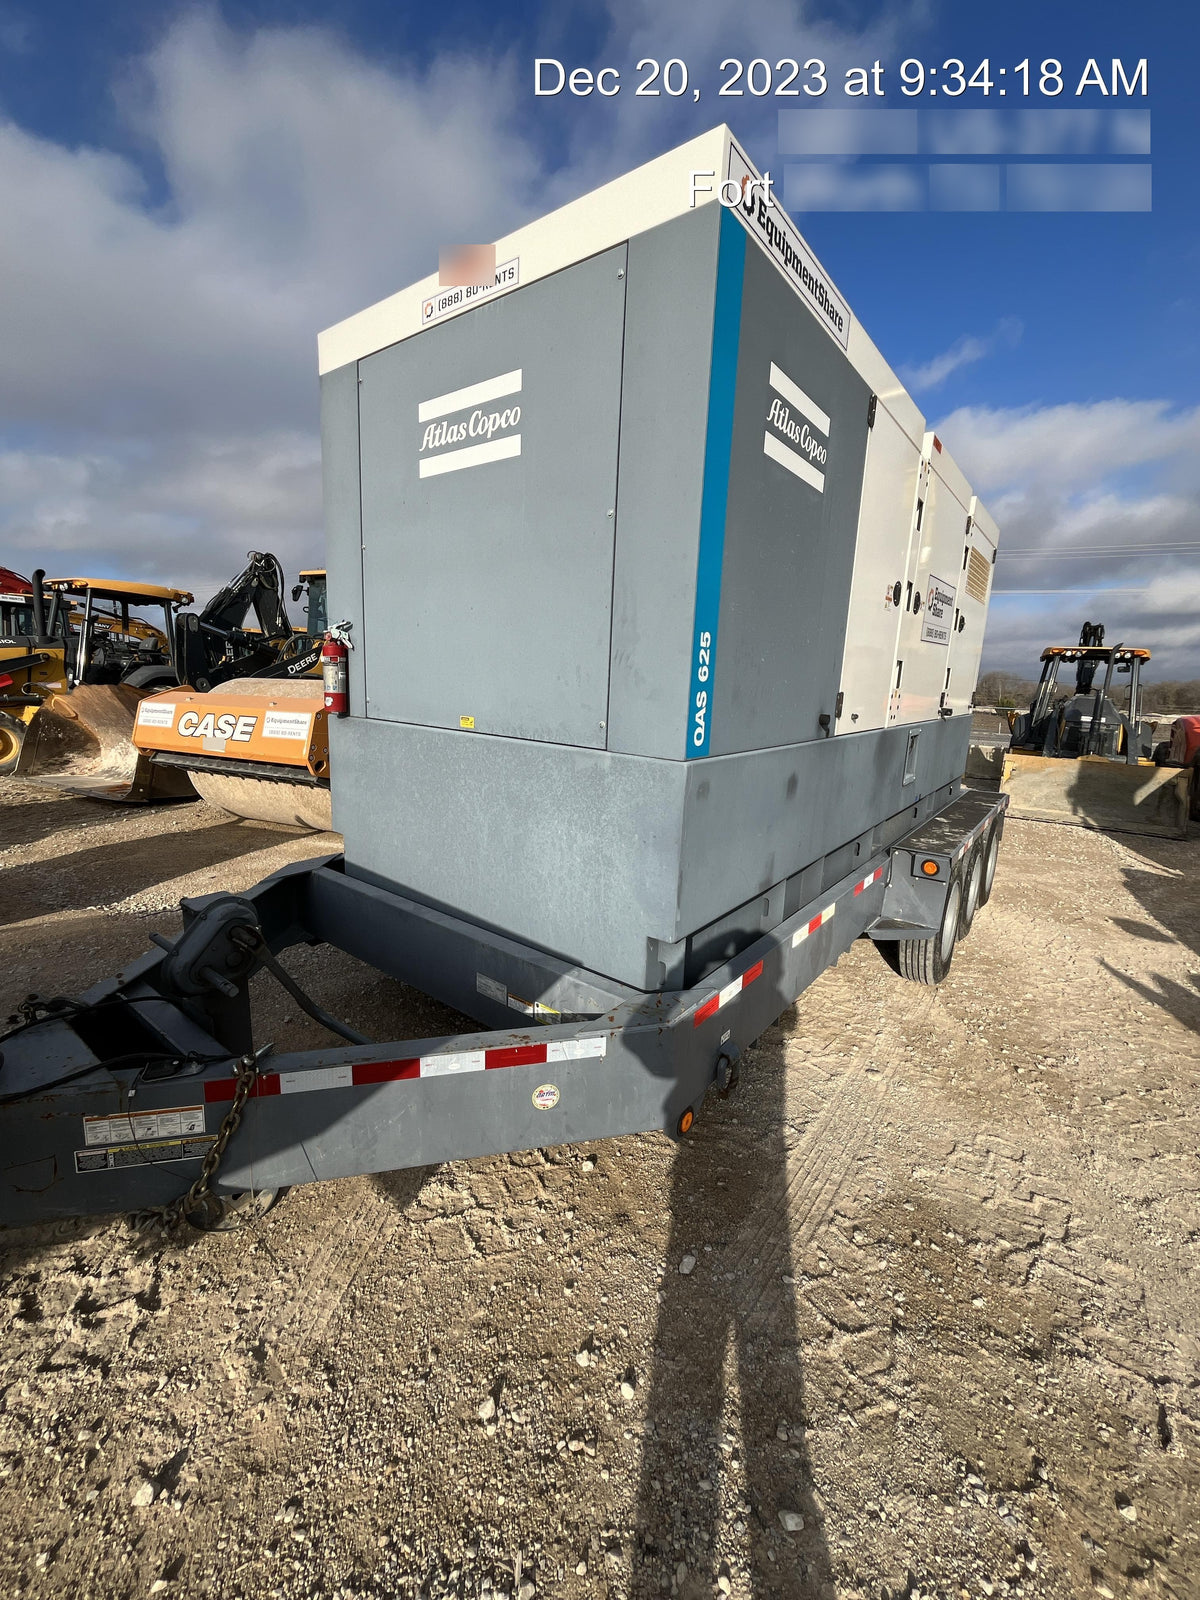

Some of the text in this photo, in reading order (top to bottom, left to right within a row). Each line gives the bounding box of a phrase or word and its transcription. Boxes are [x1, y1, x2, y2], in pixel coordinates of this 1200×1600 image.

[757, 197, 844, 333] EquipmentShare
[438, 289, 463, 312] (888)
[419, 406, 521, 452] Atlas Copco
[766, 398, 827, 465] Atlas Copco
[287, 652, 318, 674] DEERE
[693, 631, 711, 747] QAS 625
[177, 711, 258, 742] CASE
